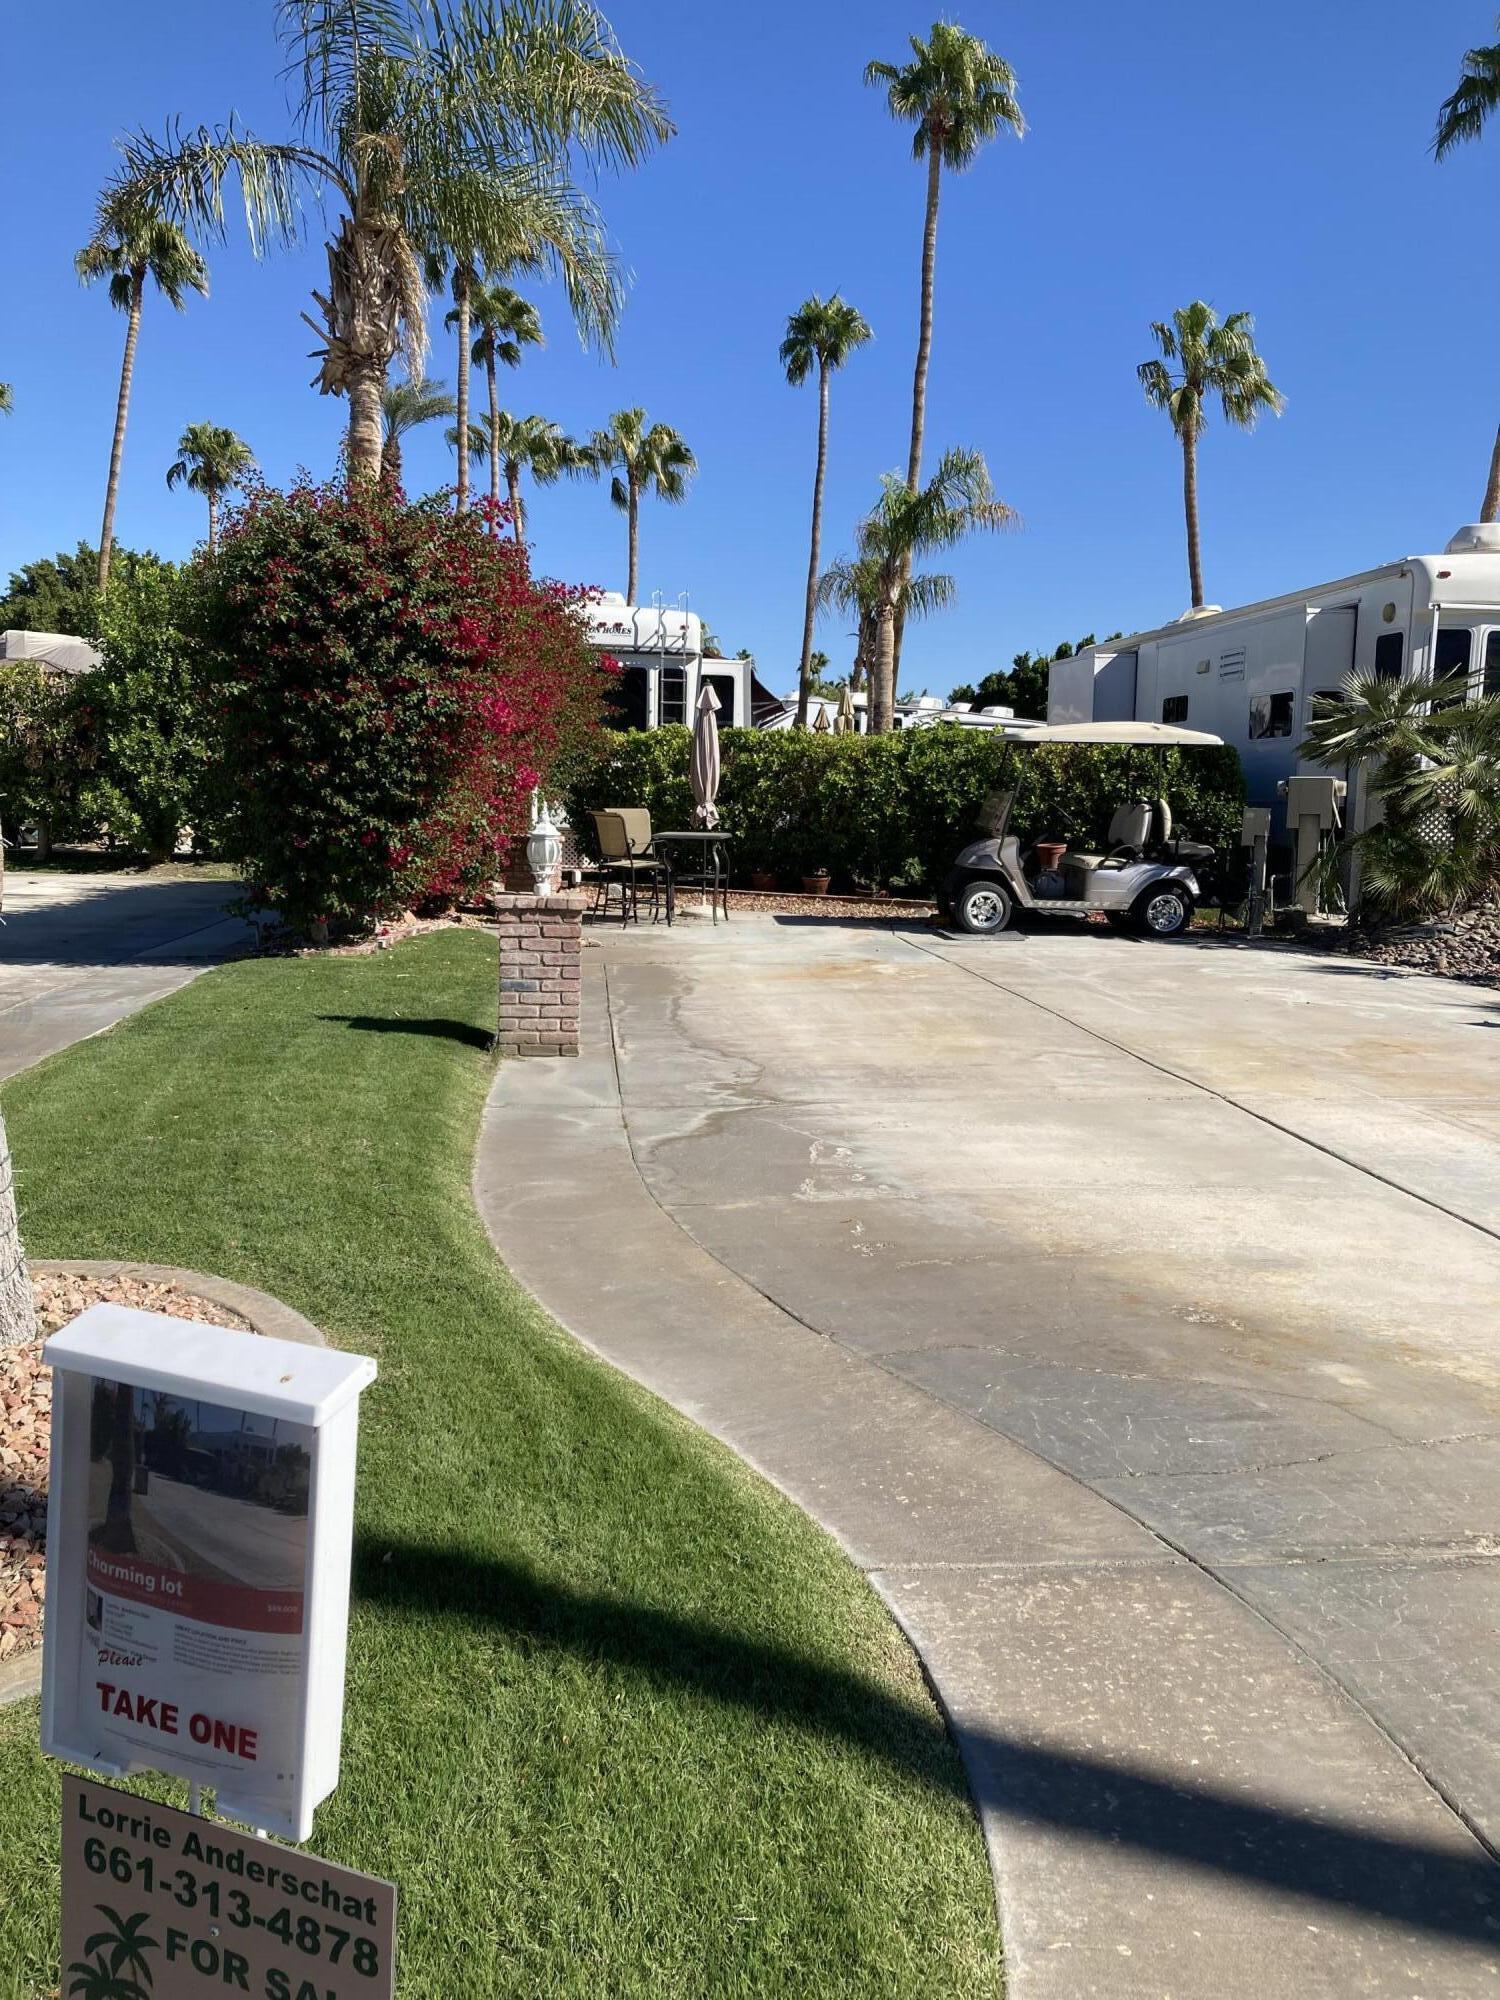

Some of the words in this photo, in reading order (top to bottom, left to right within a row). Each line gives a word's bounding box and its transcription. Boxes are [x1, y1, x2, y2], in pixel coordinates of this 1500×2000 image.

[602, 626, 632, 634] HOMES
[87, 1549, 156, 1592] Charming
[161, 1575, 184, 1597] lot
[97, 1647, 143, 1667] Please
[96, 1682, 179, 1735] TAKE
[189, 1713, 258, 1761] ONE
[79, 1793, 171, 1849] Lorrie
[181, 1831, 377, 1927] Anderschat
[83, 1837, 379, 1978] 661-313-4878
[166, 1926, 250, 1993] FOR
